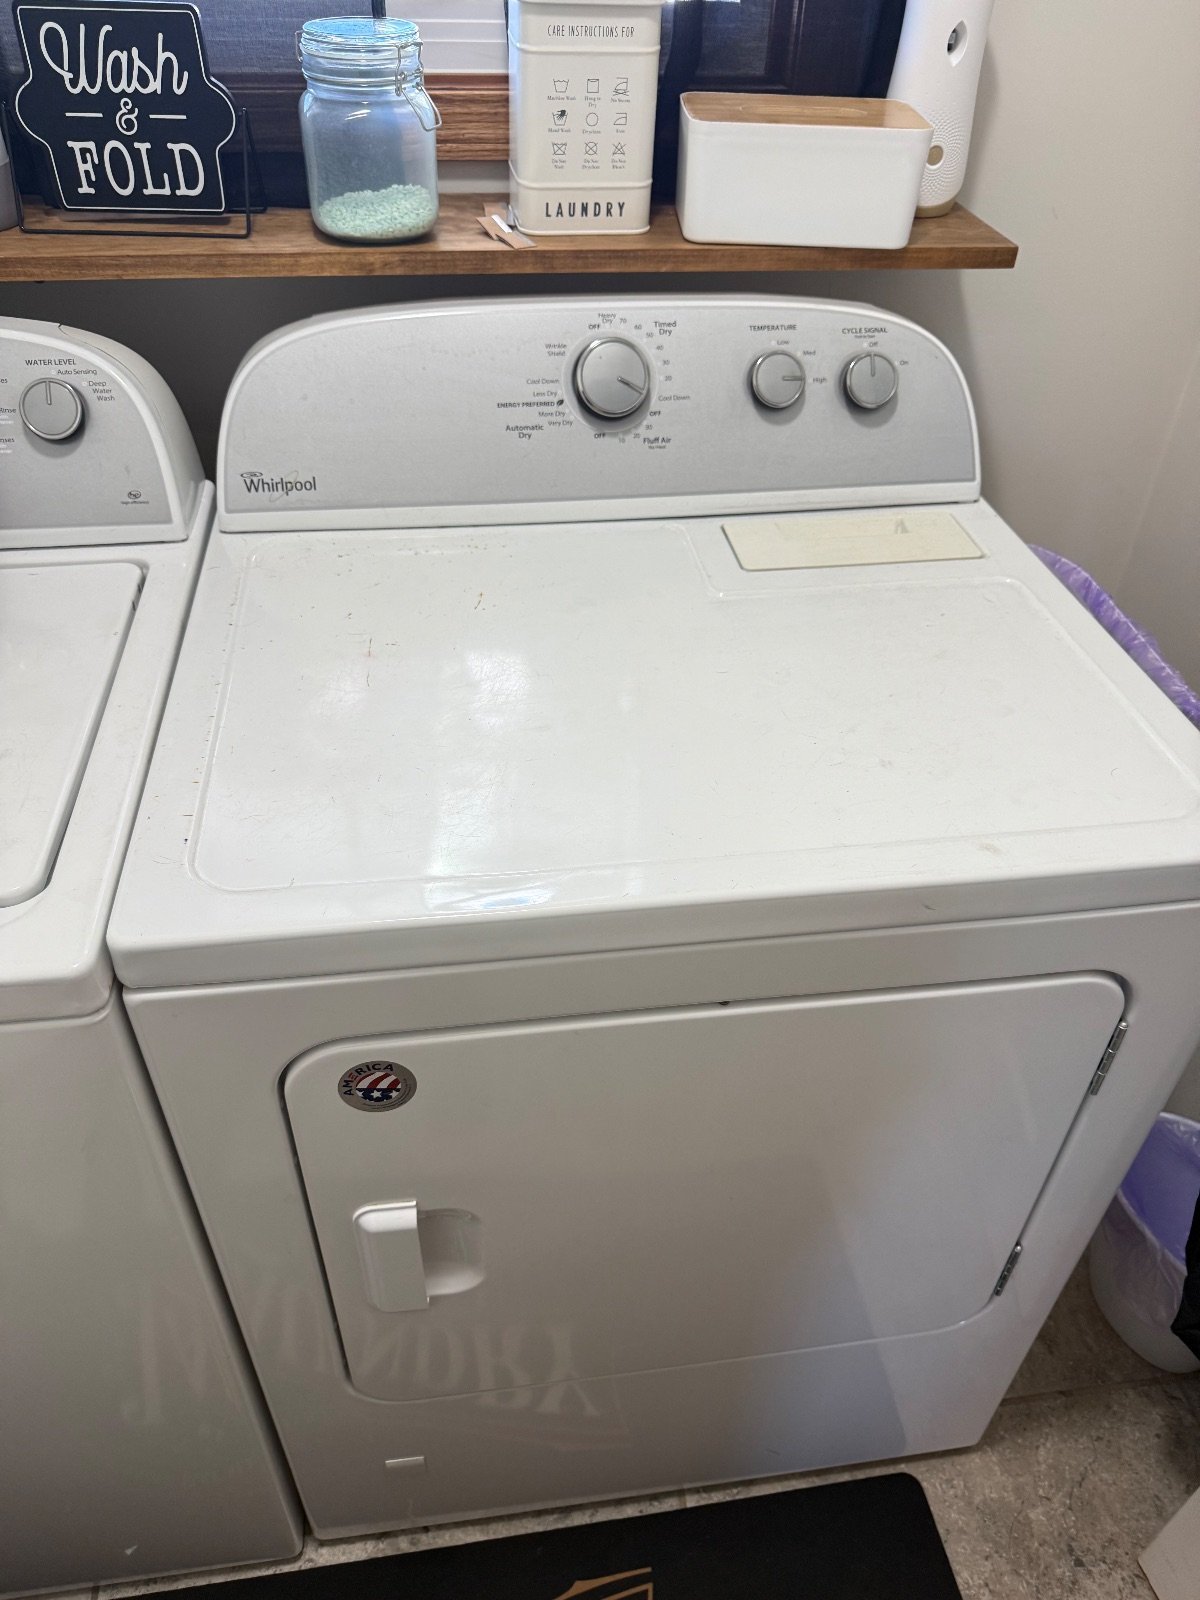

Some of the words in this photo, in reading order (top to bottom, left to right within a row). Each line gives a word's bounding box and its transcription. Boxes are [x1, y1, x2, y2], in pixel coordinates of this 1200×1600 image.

[547, 24, 565, 37] CARE
[568, 25, 619, 38] INSTRUCTIONS
[621, 26, 635, 38] FOR
[39, 21, 189, 95] Wash
[115, 97, 139, 136] &
[66, 139, 205, 196] FOLD
[545, 202, 625, 218] LAUNDRY
[653, 320, 677, 328] Timed
[659, 328, 672, 336] Dry
[505, 424, 544, 432] Automatic
[518, 432, 532, 440] Dry
[643, 436, 660, 444] Fluff
[243, 476, 317, 496] Whirlpool
[343, 1063, 394, 1096] AMERICA
